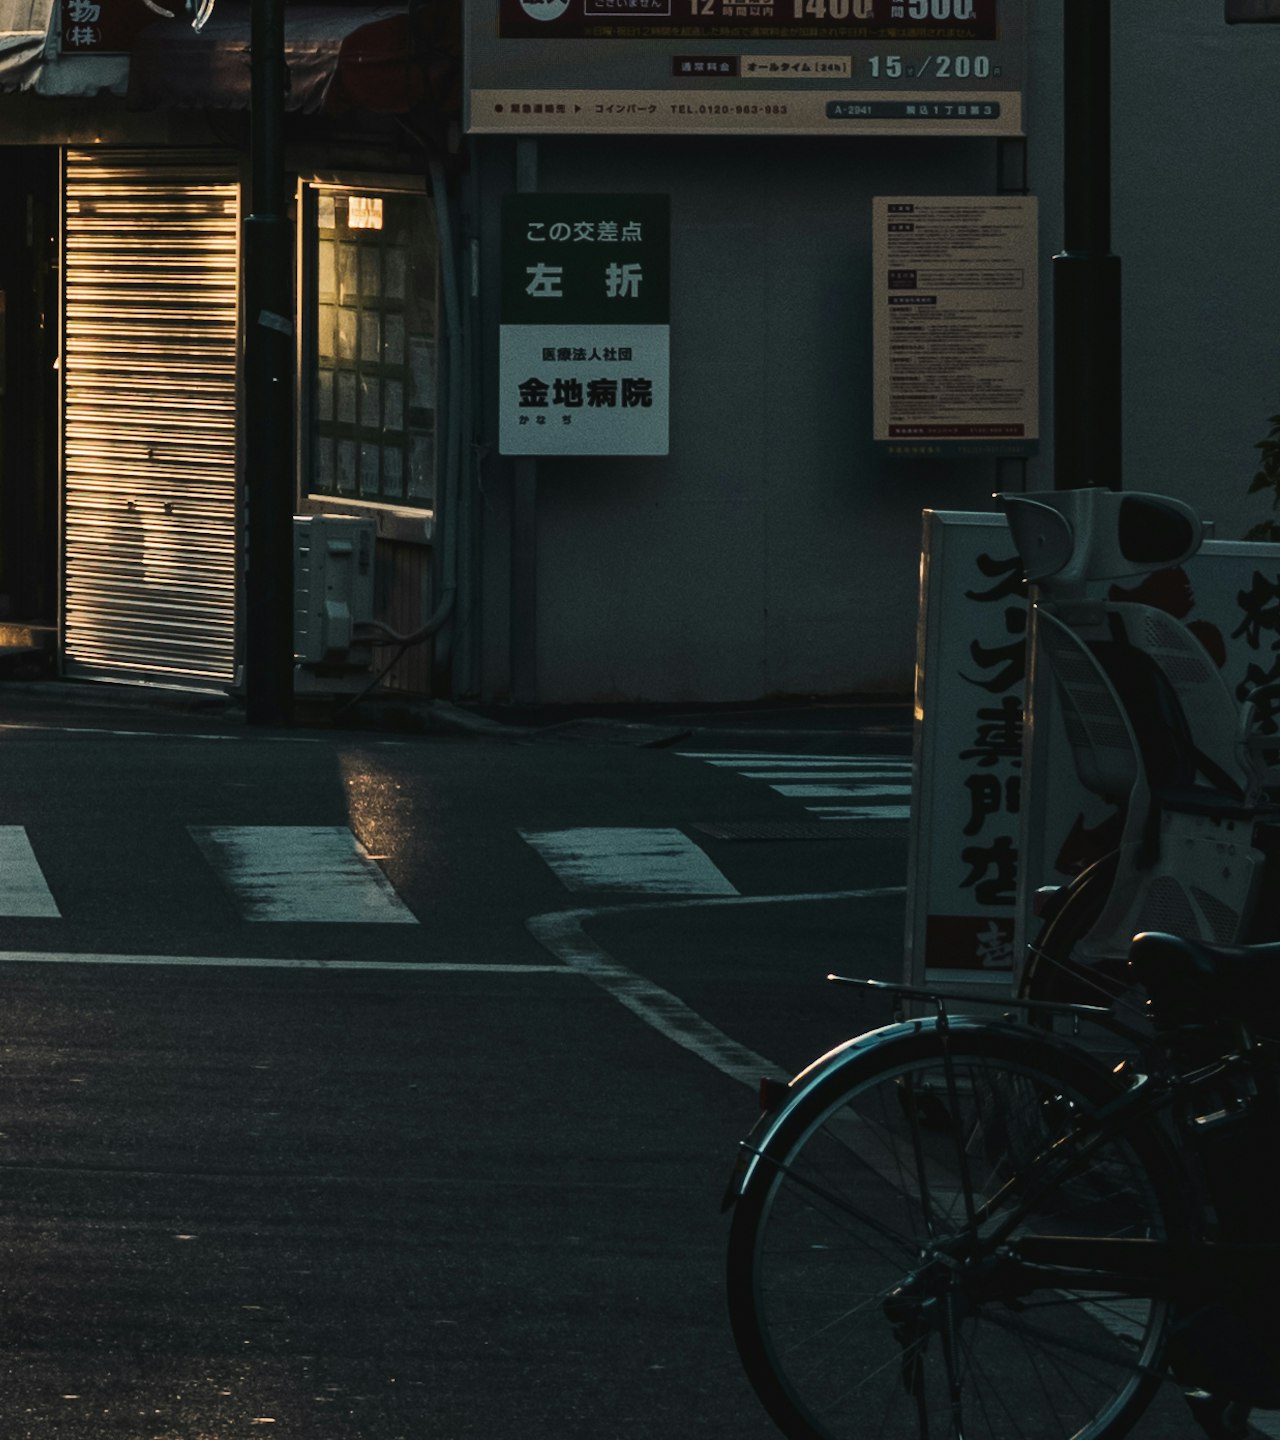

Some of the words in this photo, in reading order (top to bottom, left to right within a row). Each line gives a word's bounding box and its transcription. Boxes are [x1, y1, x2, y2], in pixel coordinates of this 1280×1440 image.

[595, 105, 657, 114] コインパーク
[526, 221, 643, 242] この交差点
[525, 262, 644, 298] 左折
[543, 347, 633, 361] 医療法人社団
[518, 378, 653, 407] 金地病院
